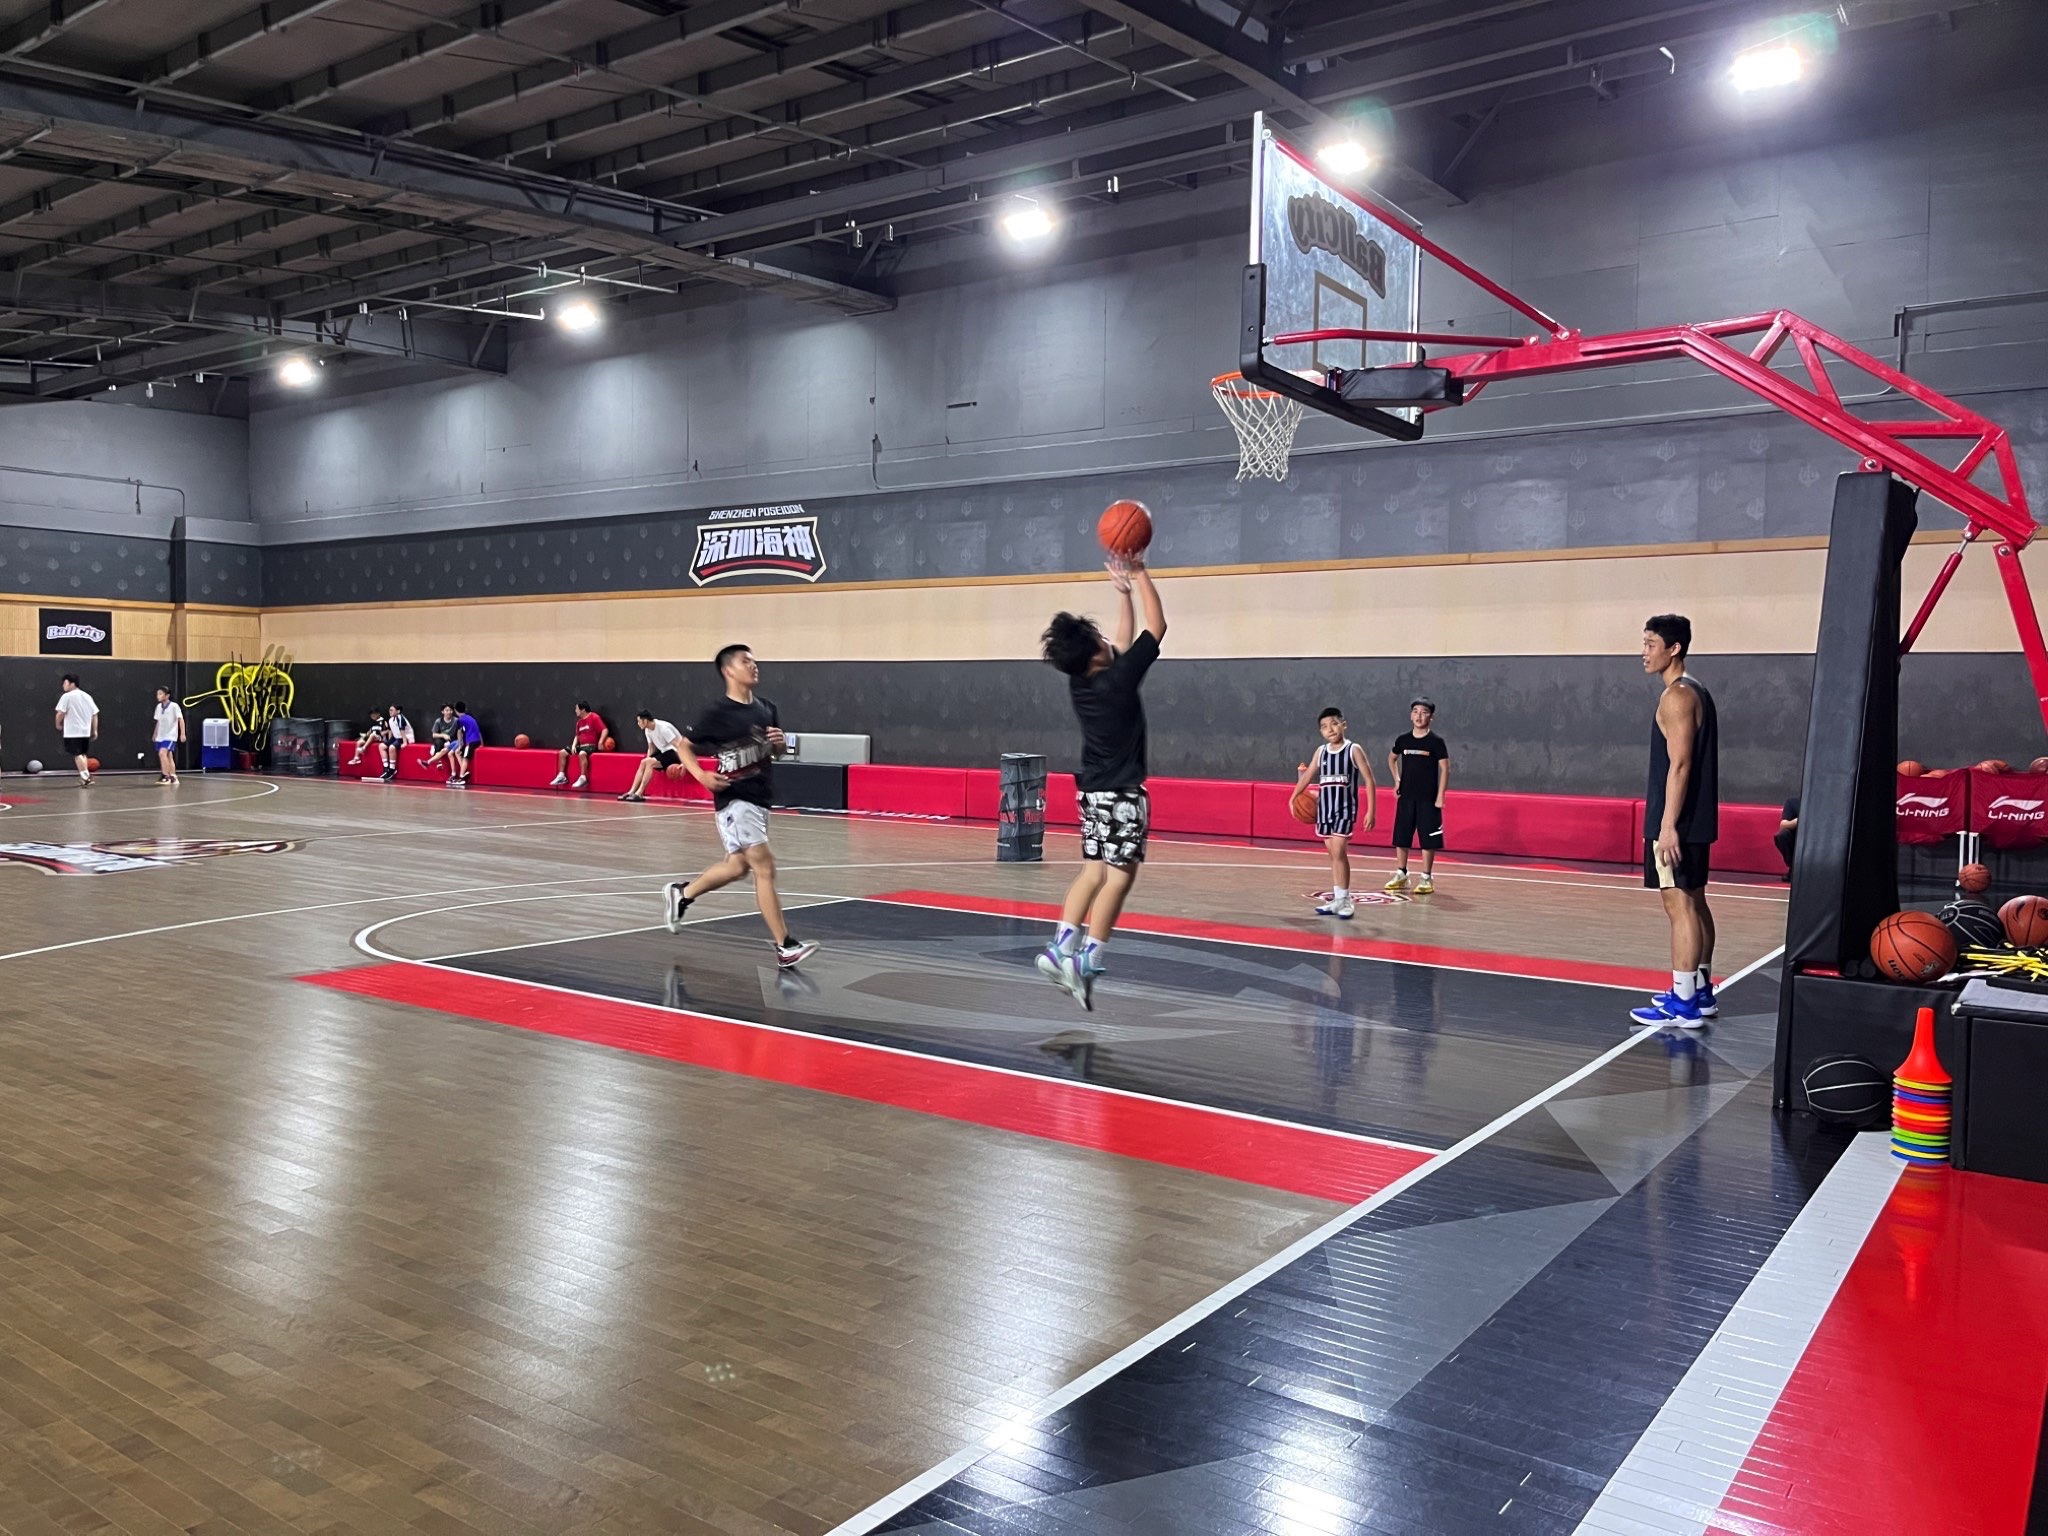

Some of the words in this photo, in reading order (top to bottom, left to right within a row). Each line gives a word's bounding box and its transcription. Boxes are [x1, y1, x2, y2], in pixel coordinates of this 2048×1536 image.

[709, 508, 757, 520] SHENZHEN
[758, 504, 805, 517] POSEIDON
[697, 525, 816, 568] 深圳海神
[47, 624, 105, 642] BallCity
[1895, 807, 1950, 818] LI-NING
[1988, 810, 2045, 821] LI-NING
